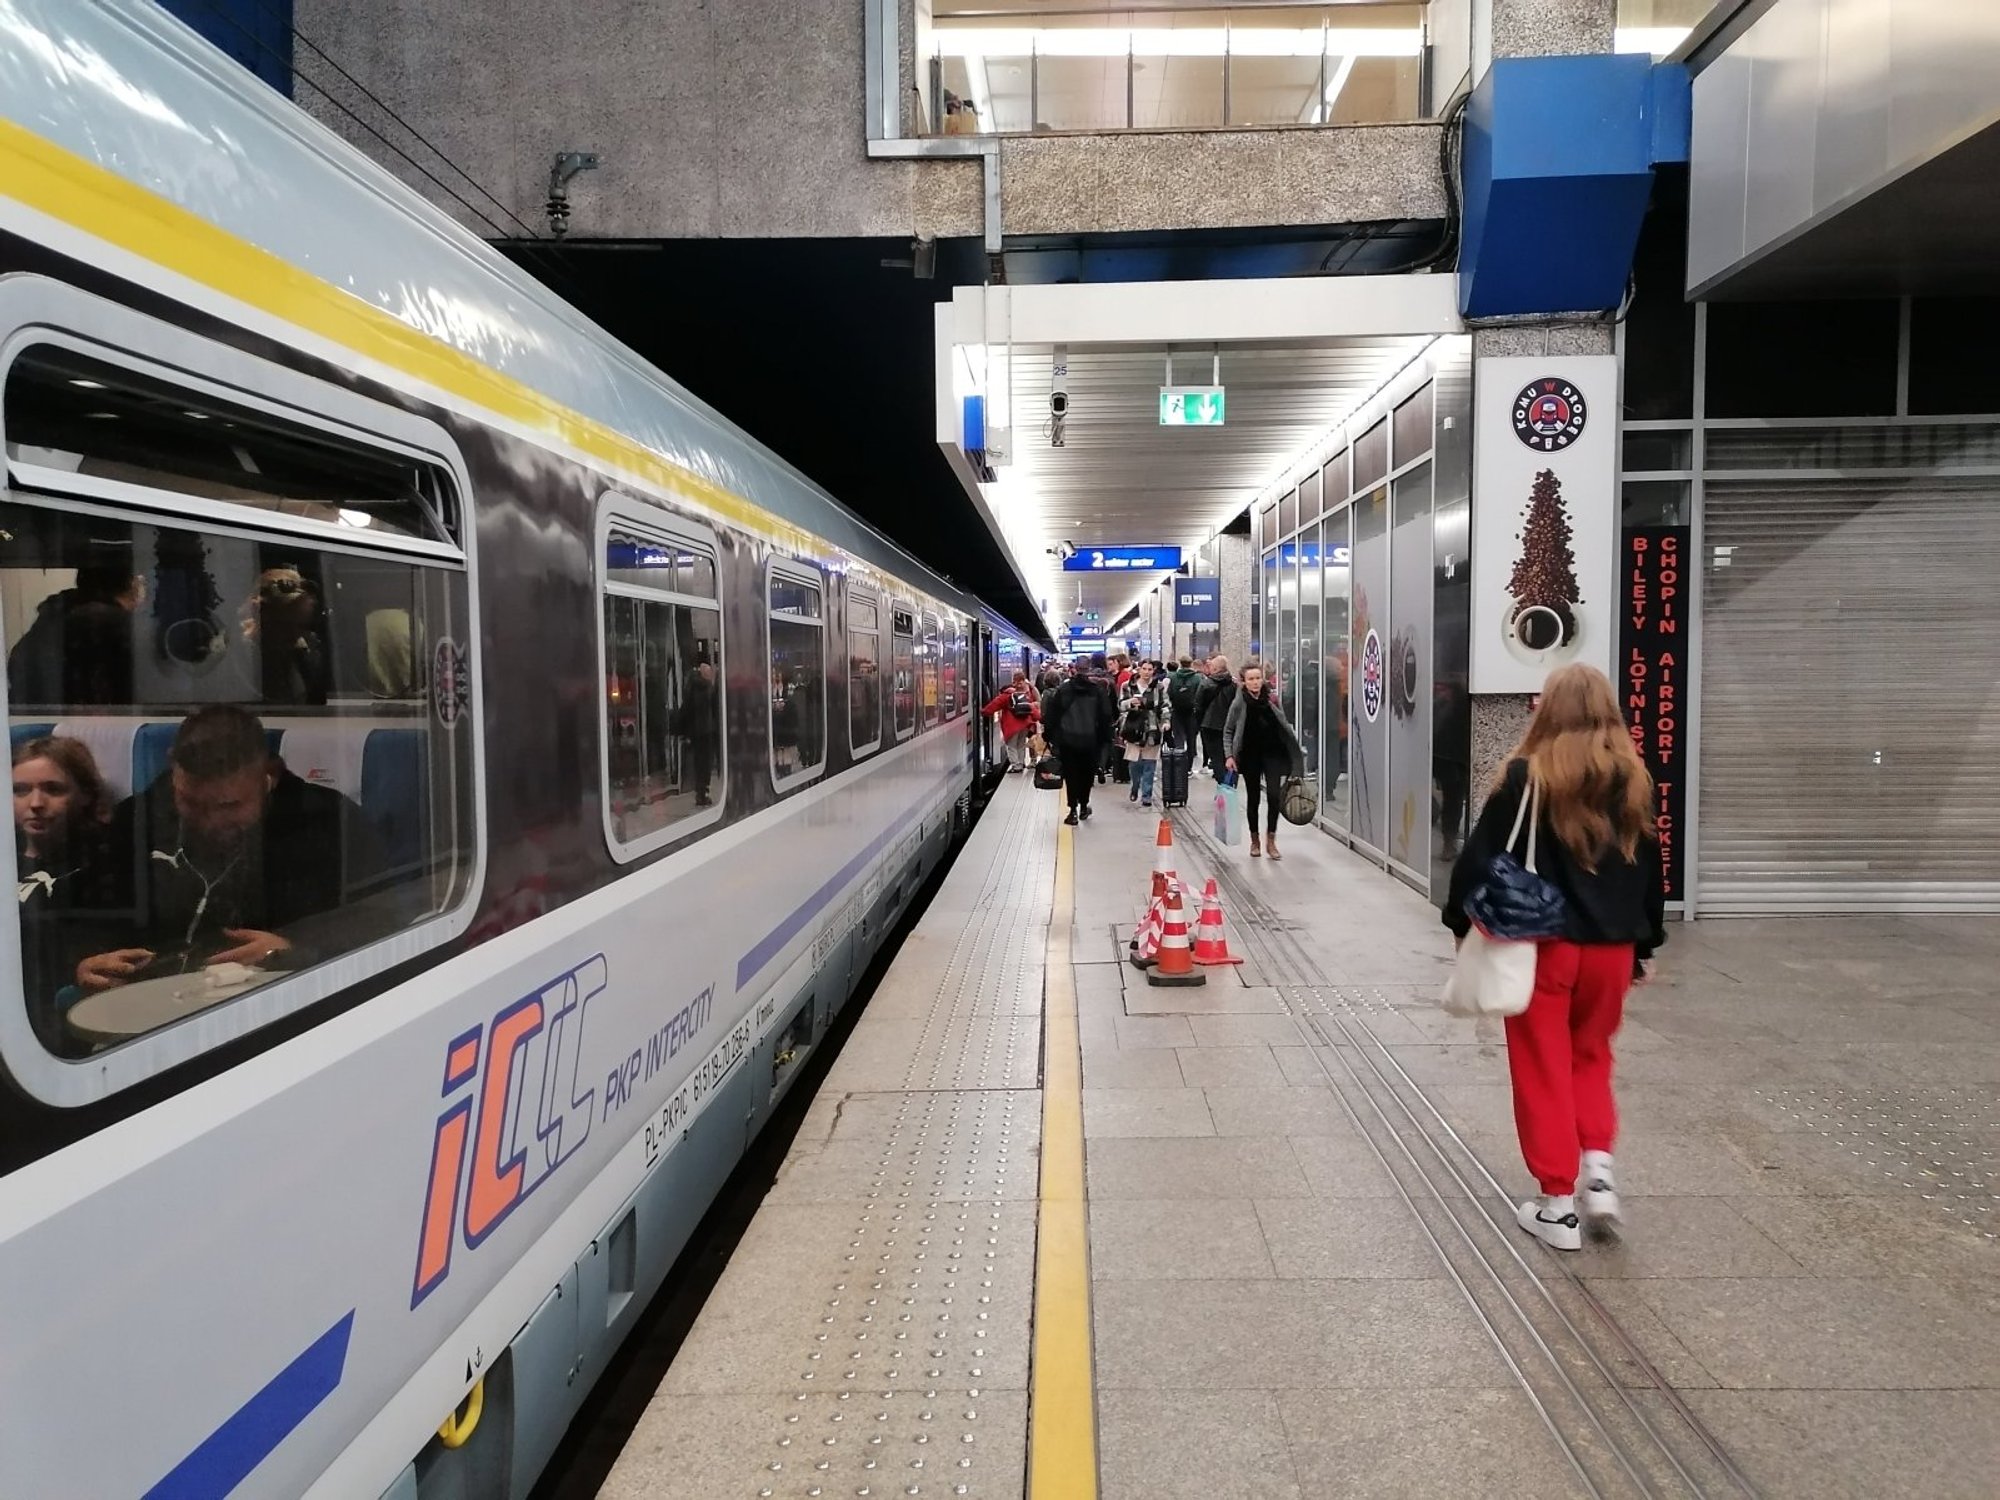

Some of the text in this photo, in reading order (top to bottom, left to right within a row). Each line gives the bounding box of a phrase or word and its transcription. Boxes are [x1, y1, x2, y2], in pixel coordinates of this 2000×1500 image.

[1054, 366, 1067, 376] 25
[1516, 388, 1537, 429] KOMU
[1544, 382, 1556, 392] W
[1092, 552, 1104, 567] 2
[1659, 537, 1677, 634] CHOPIN
[1629, 537, 1648, 766] BILETY LOTNISK
[1657, 652, 1676, 764] AIRPORT
[603, 982, 716, 1125] PKP INTERCITY
